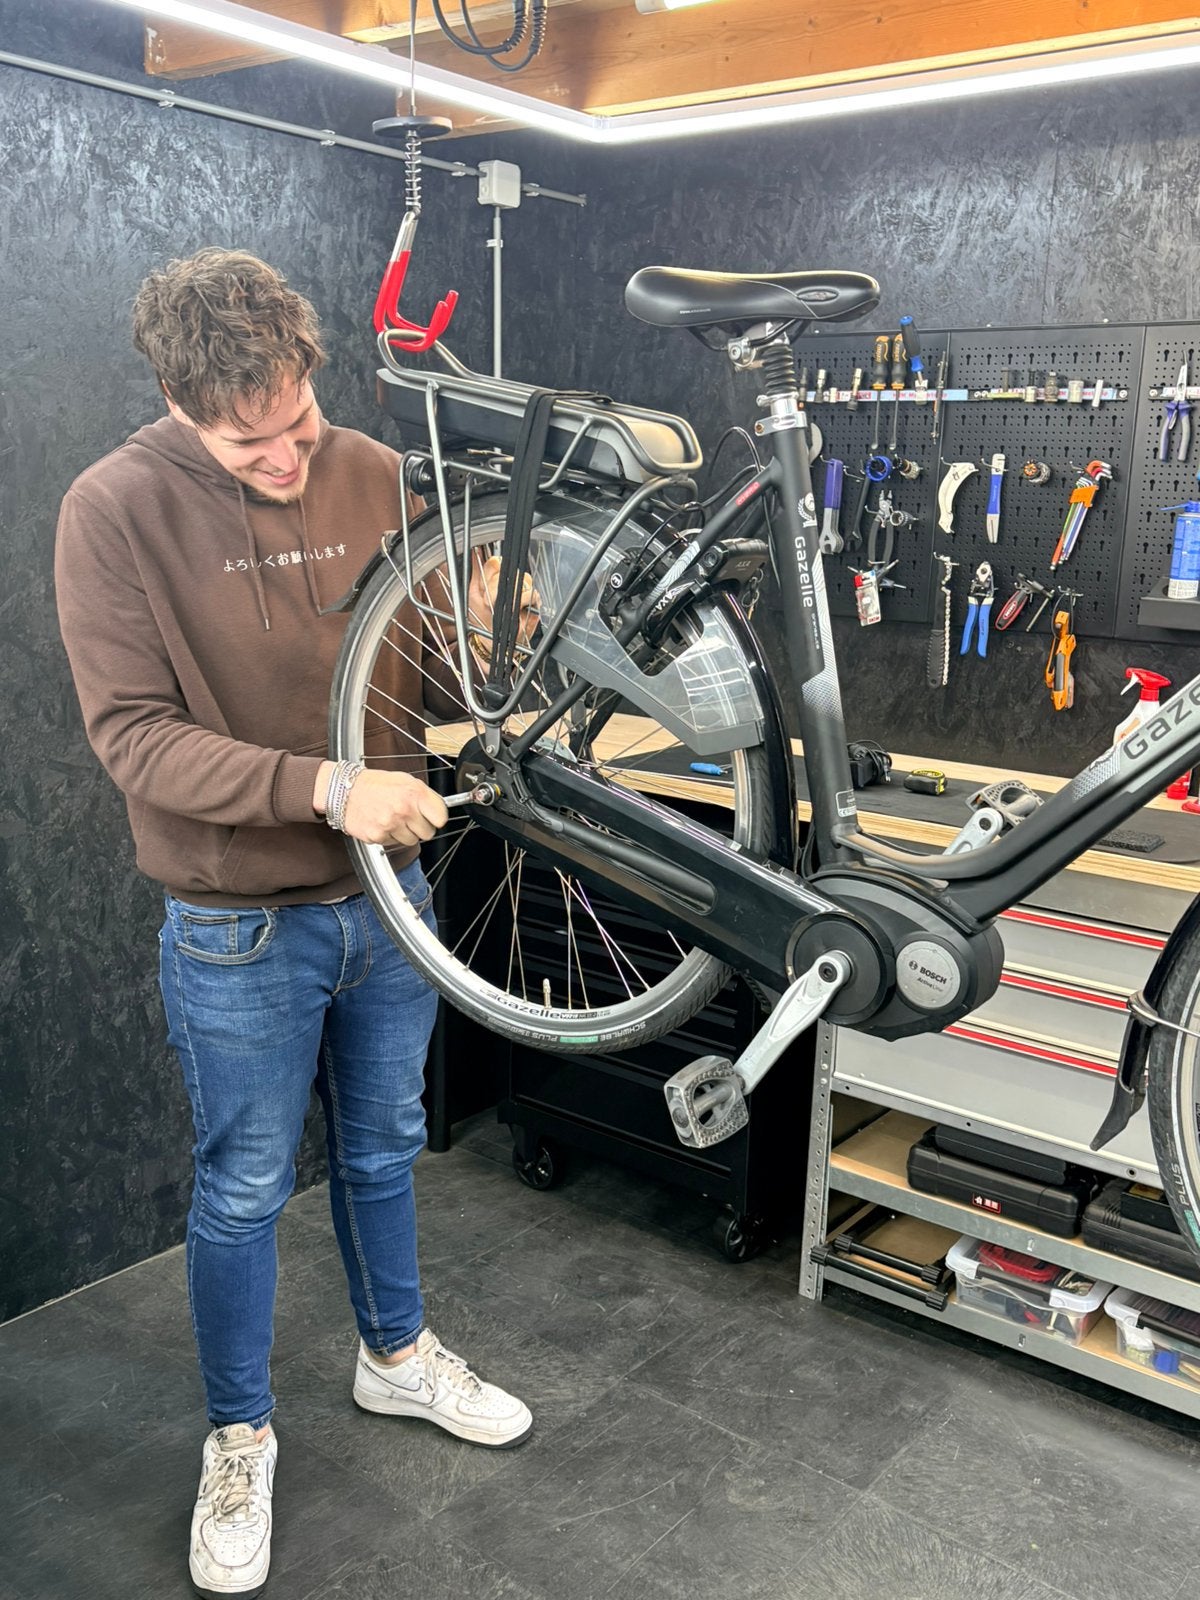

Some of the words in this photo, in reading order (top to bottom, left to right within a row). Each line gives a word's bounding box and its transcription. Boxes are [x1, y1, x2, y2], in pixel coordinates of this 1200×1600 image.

[223, 543, 347, 572] よろしくお願いします
[794, 536, 814, 608] Gazelle
[919, 967, 947, 984] BOSCH
[497, 996, 560, 1019] Gazelle
[531, 1031, 558, 1043] PLUS
[600, 1020, 646, 1041] SCHWALBE
[1171, 1162, 1190, 1206] PLUS
